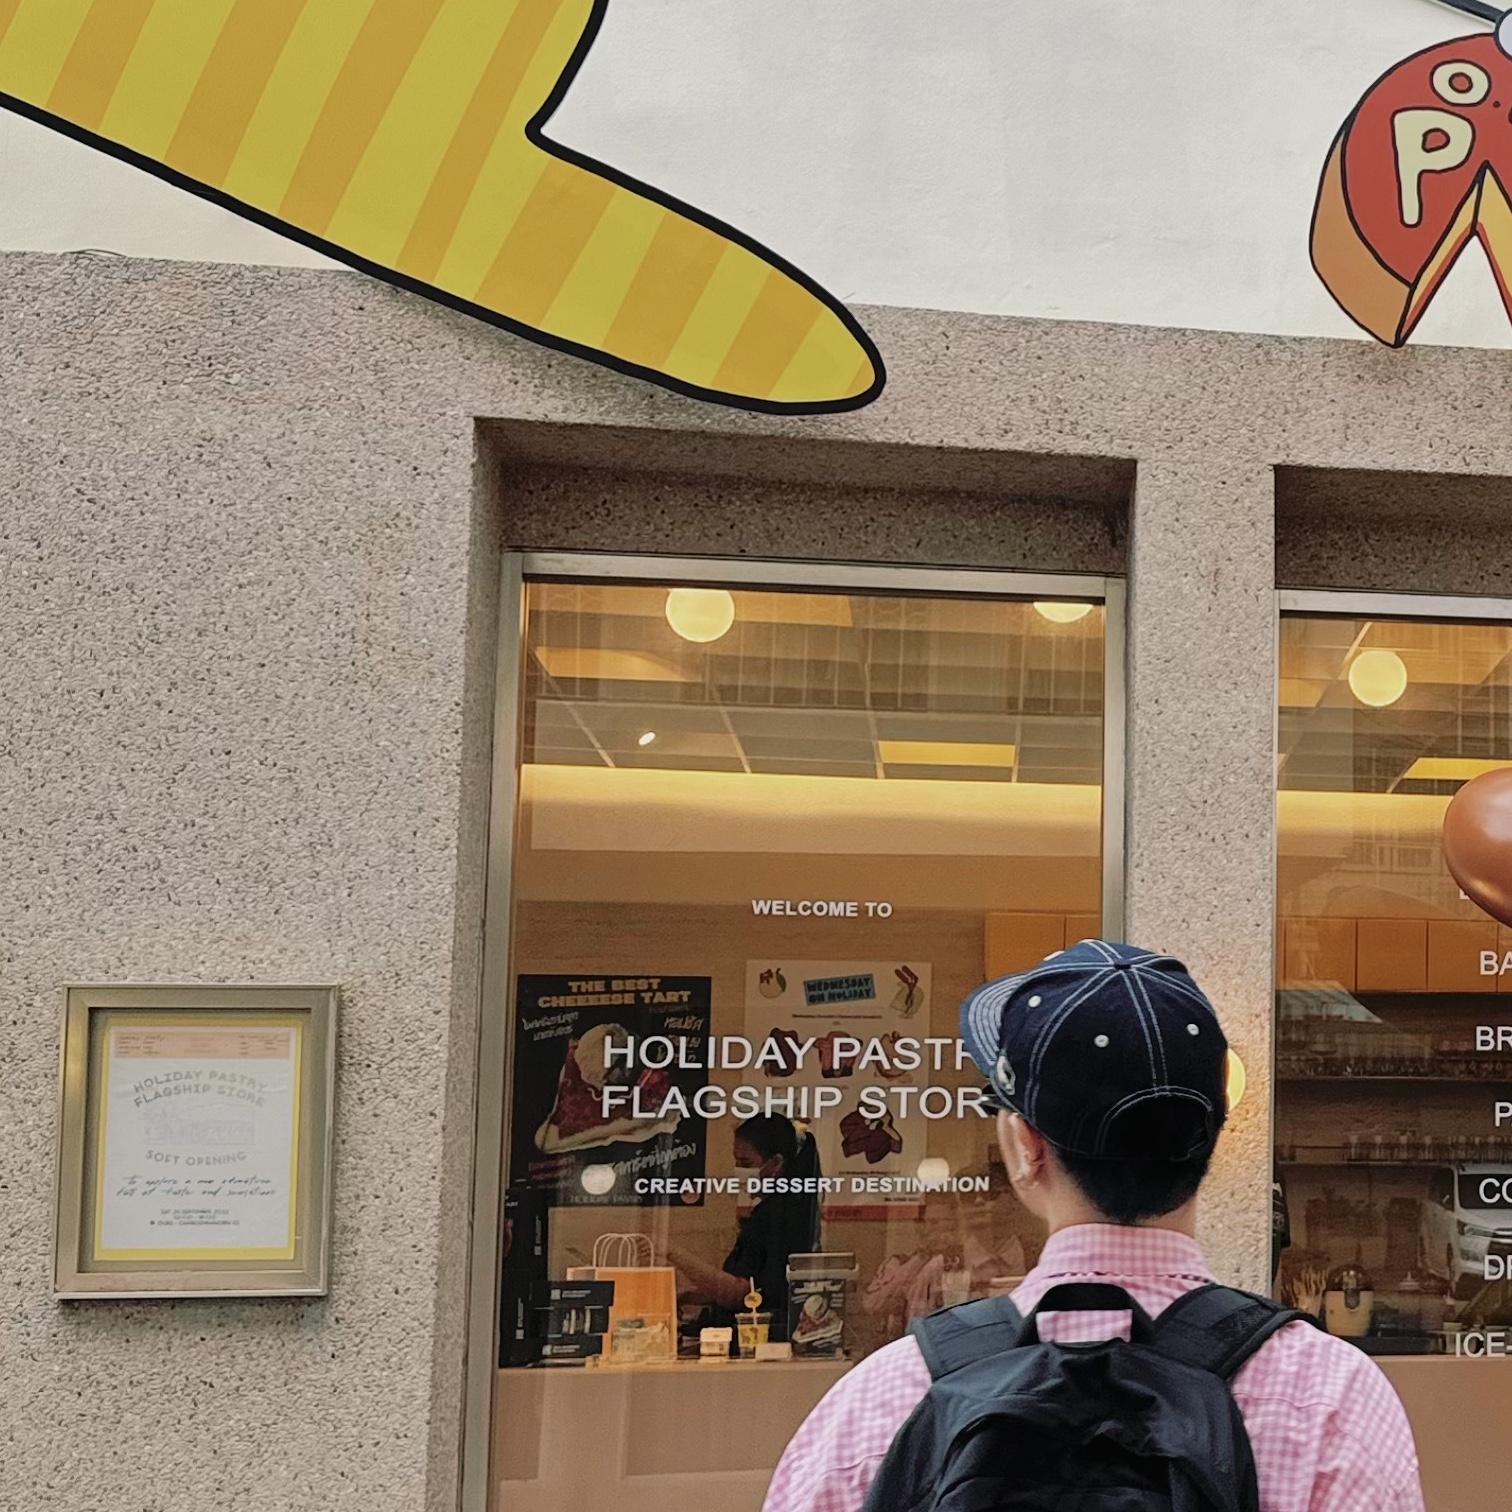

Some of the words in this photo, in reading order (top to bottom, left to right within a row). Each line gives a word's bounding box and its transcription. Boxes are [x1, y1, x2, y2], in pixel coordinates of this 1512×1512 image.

[752, 899, 858, 917] WELCOME
[865, 901, 893, 918] TO
[568, 981, 606, 993] THE
[611, 979, 661, 991] BEST
[806, 977, 870, 992] WEDNESDAY
[641, 991, 691, 1004] TART
[828, 987, 872, 1001] HOLIDAY
[604, 1035, 816, 1069] HOLIDAY
[133, 1070, 203, 1094] HOLIDAY
[208, 1070, 268, 1093] PASTRY
[133, 1084, 211, 1108] FLAGSHIP
[216, 1085, 267, 1108] STORE
[602, 1085, 842, 1119] FLAGSHIP
[858, 1086, 993, 1120] STOR
[145, 1150, 181, 1165] SOFT
[185, 1151, 248, 1167] OPENING
[634, 1178, 740, 1193] CREATIVE
[747, 1177, 844, 1193] DESSERT
[851, 1176, 990, 1193] DESTINATION
